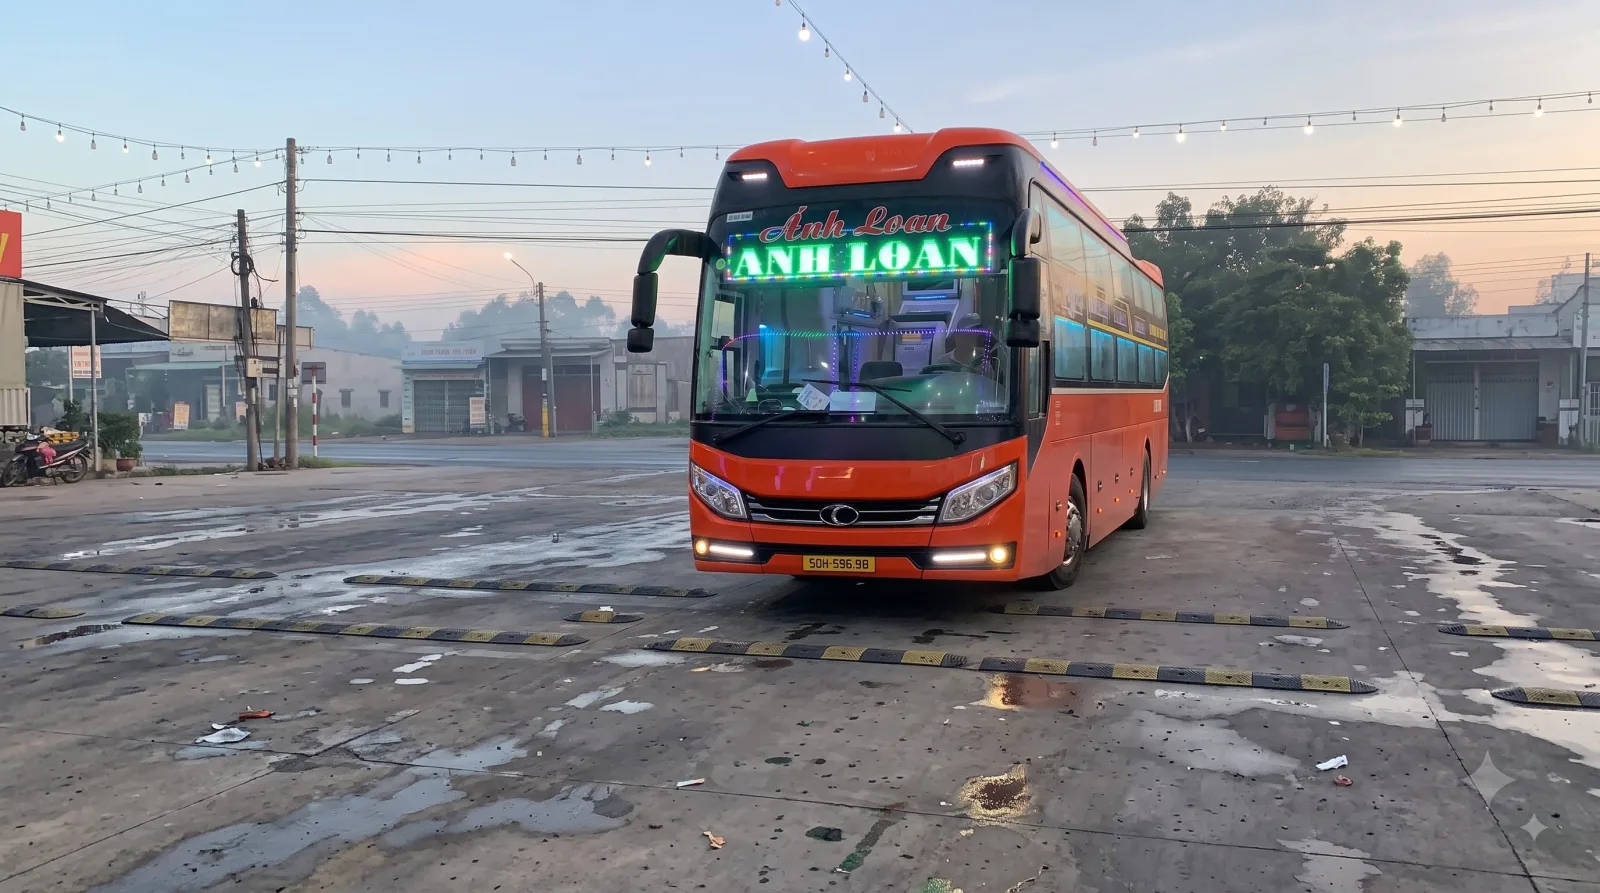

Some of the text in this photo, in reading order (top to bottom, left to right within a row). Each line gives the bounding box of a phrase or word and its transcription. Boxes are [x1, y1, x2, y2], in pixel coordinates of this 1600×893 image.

[759, 205, 952, 244] Ánh Loan
[734, 236, 981, 277] ANH LOAN
[809, 557, 869, 569] 50H-596.98
